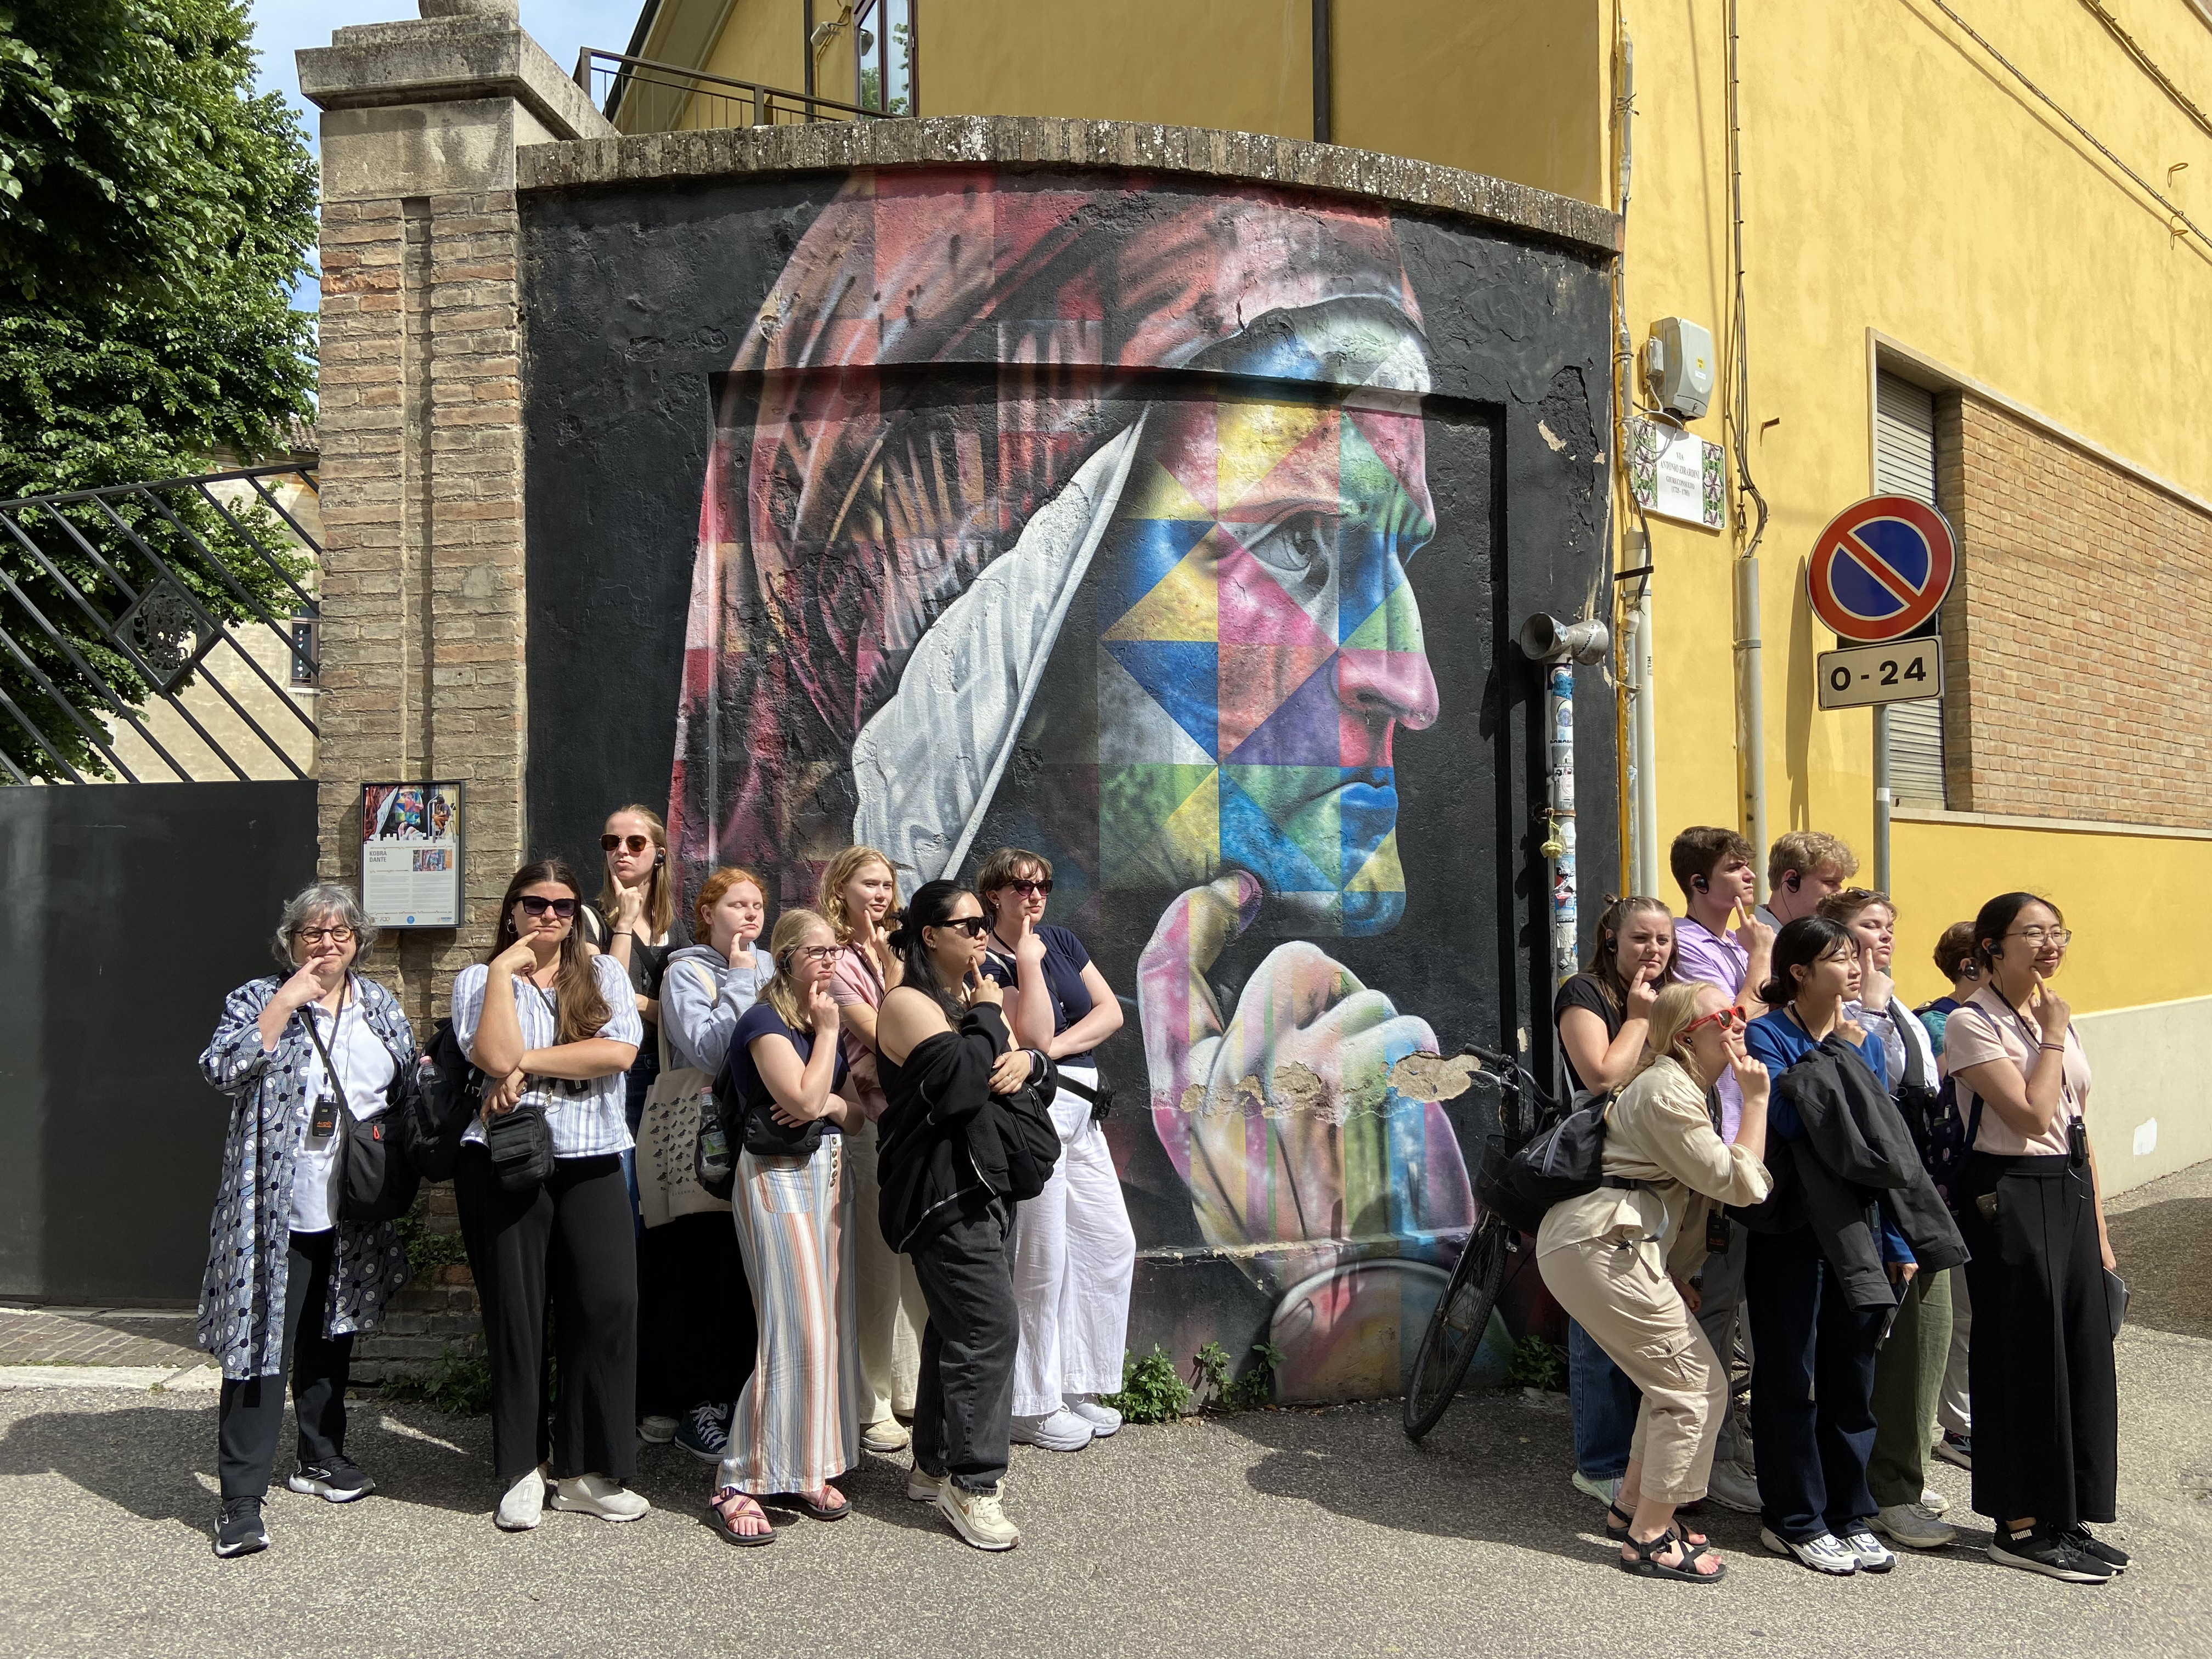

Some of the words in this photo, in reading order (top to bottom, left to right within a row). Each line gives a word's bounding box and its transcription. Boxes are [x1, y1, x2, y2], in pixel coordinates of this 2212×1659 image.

[1676, 452, 1684, 461] VIA
[1660, 460, 1679, 472] ANTONIO
[1679, 466, 1700, 479] ZIRARDINI
[1879, 657, 1926, 686] 24
[2010, 1529, 2033, 1541] PUMA
